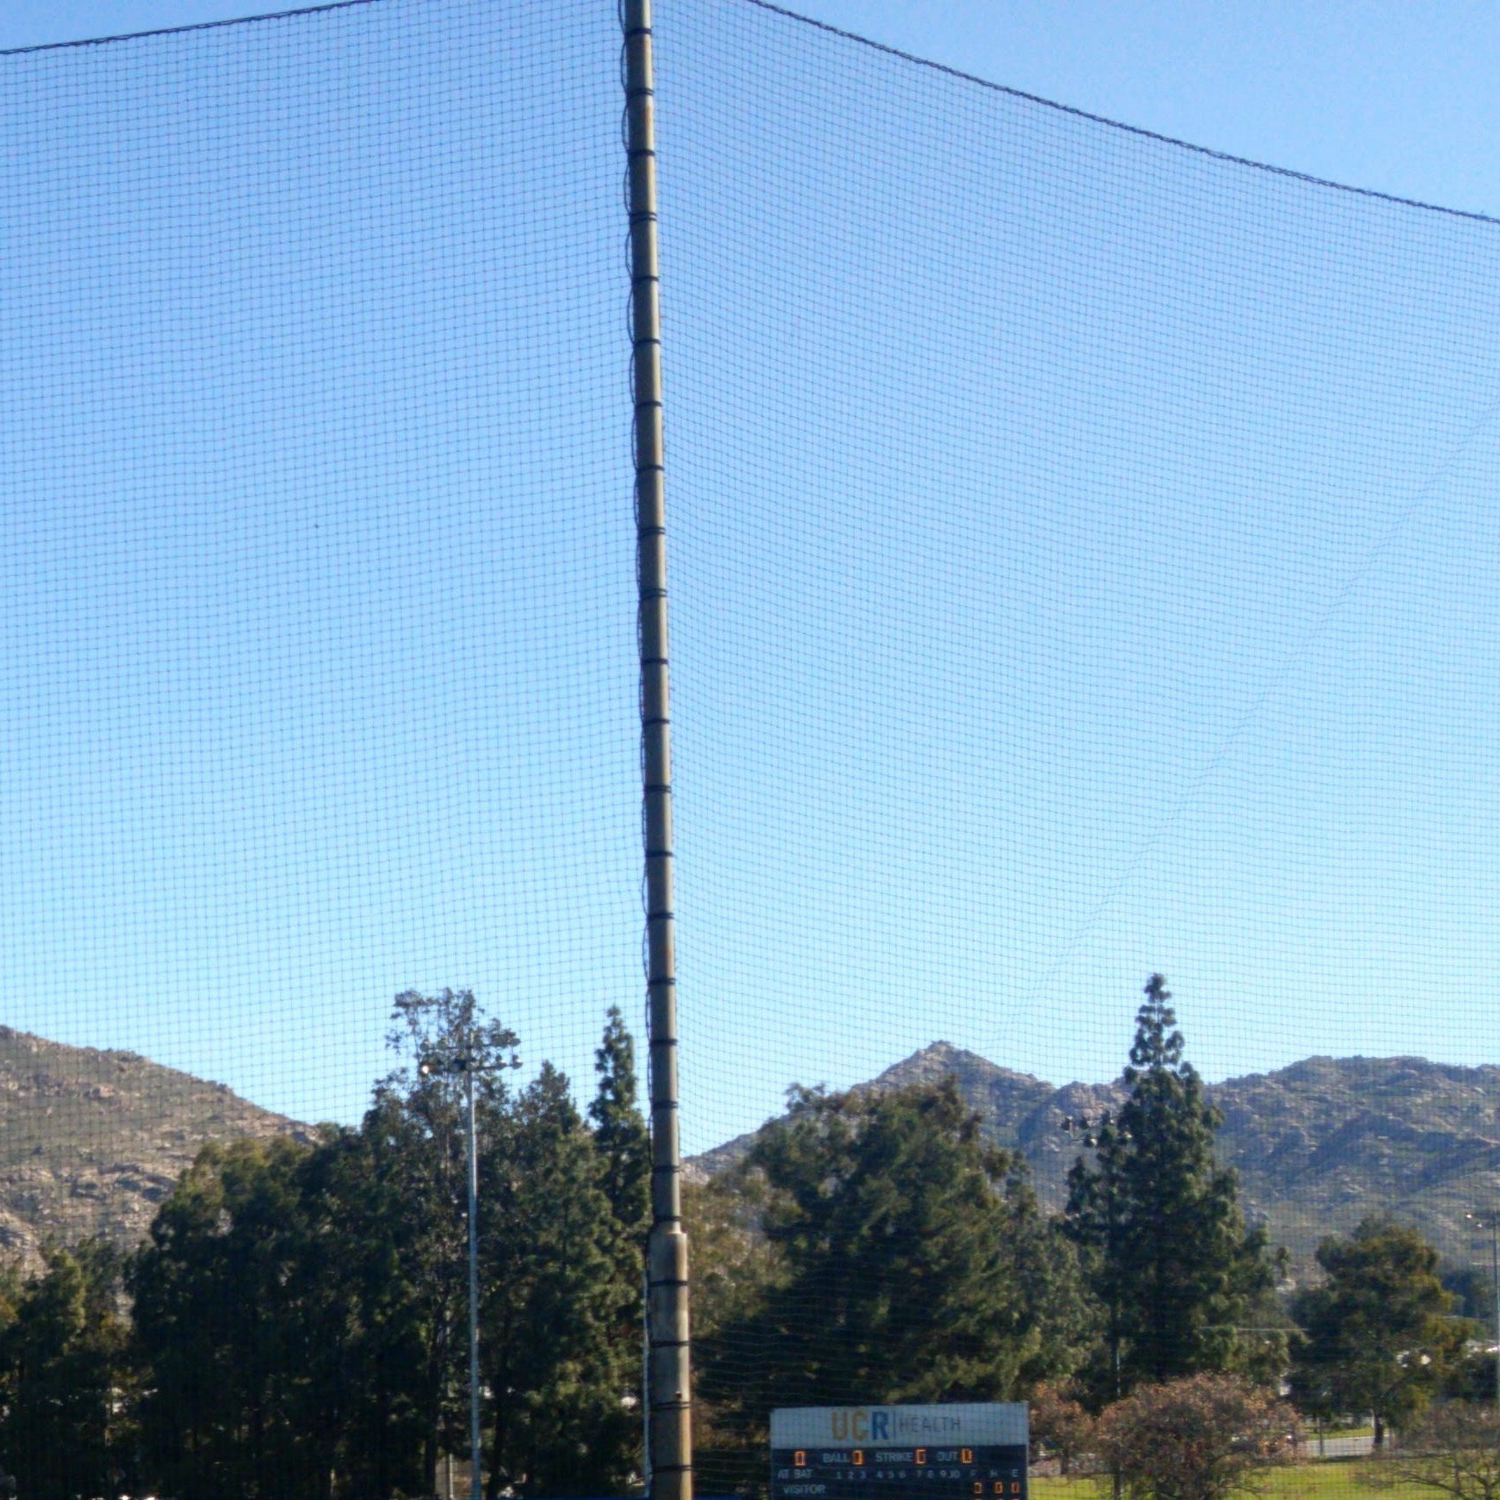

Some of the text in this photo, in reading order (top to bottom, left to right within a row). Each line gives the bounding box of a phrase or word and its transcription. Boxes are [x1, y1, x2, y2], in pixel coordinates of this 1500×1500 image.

[831, 1409, 961, 1441] UCR HEALTH
[822, 1452, 850, 1463] BALL
[875, 1451, 913, 1463] STRIKE
[936, 1451, 959, 1462] OUT
[778, 1469, 790, 1479] AT
[794, 1469, 813, 1478] BAT
[783, 1484, 826, 1494] VISITOR
